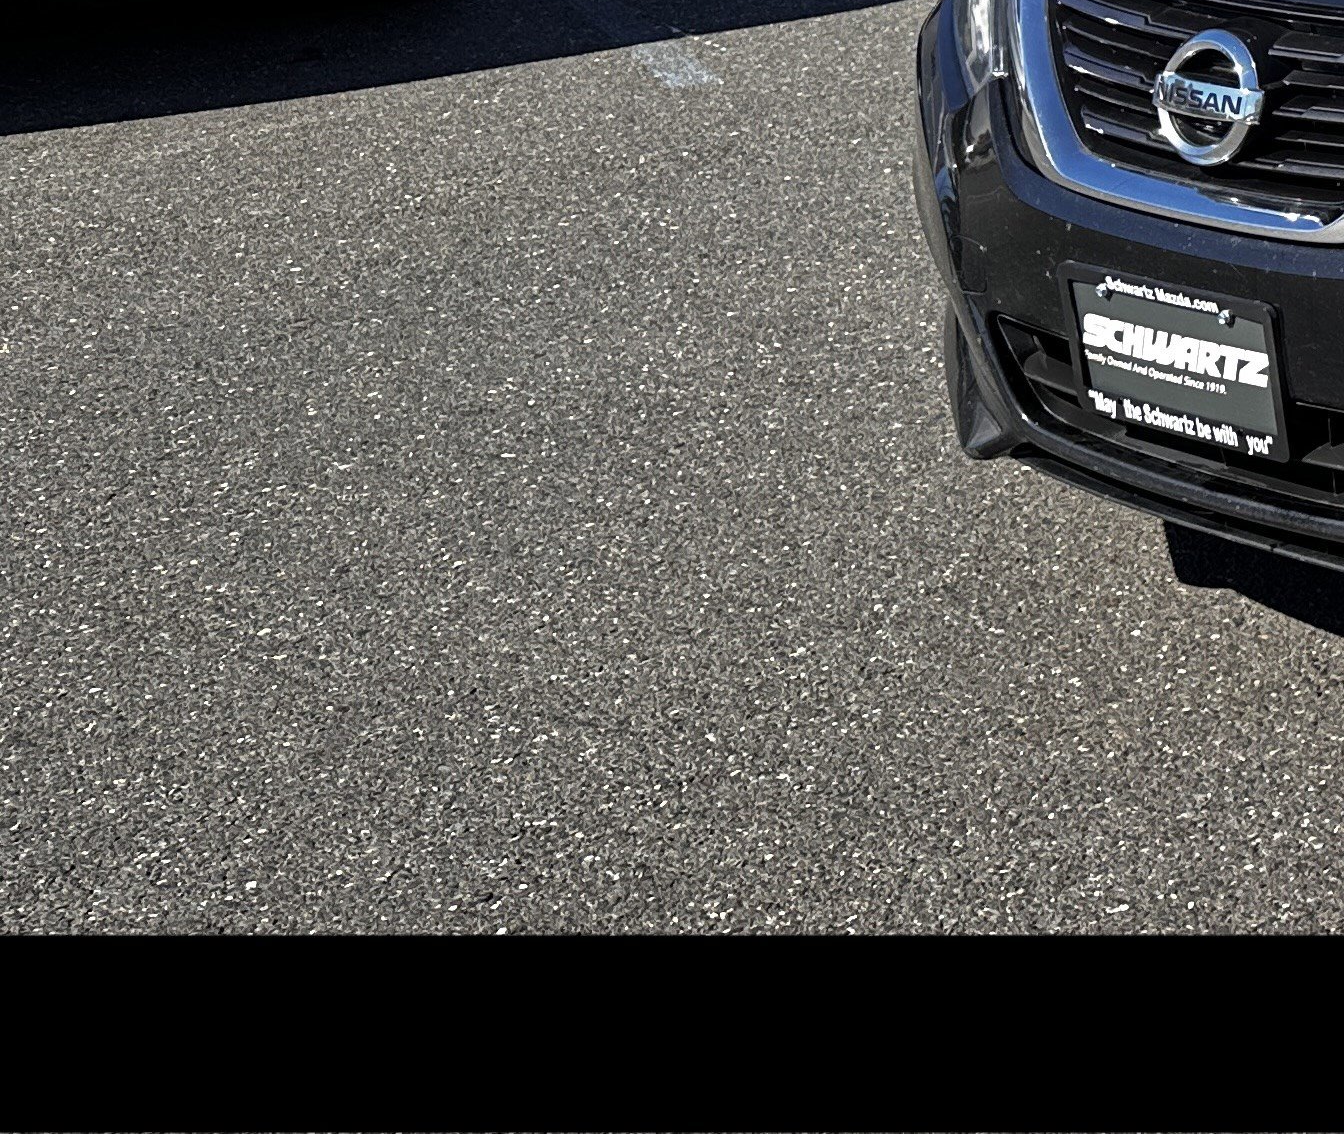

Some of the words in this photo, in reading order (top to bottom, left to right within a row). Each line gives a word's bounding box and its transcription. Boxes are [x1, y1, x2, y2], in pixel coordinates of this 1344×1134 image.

[1156, 76, 1243, 115] NISSAN
[1105, 275, 1155, 301] Schwartz
[1155, 287, 1219, 314] Mazda.com
[1083, 313, 1270, 388] SCHWARTZ
[1183, 375, 1204, 389] Since
[1122, 398, 1143, 421] the
[1143, 403, 1196, 437] Schwartz
[1196, 417, 1212, 440] be
[1212, 424, 1239, 447] with
